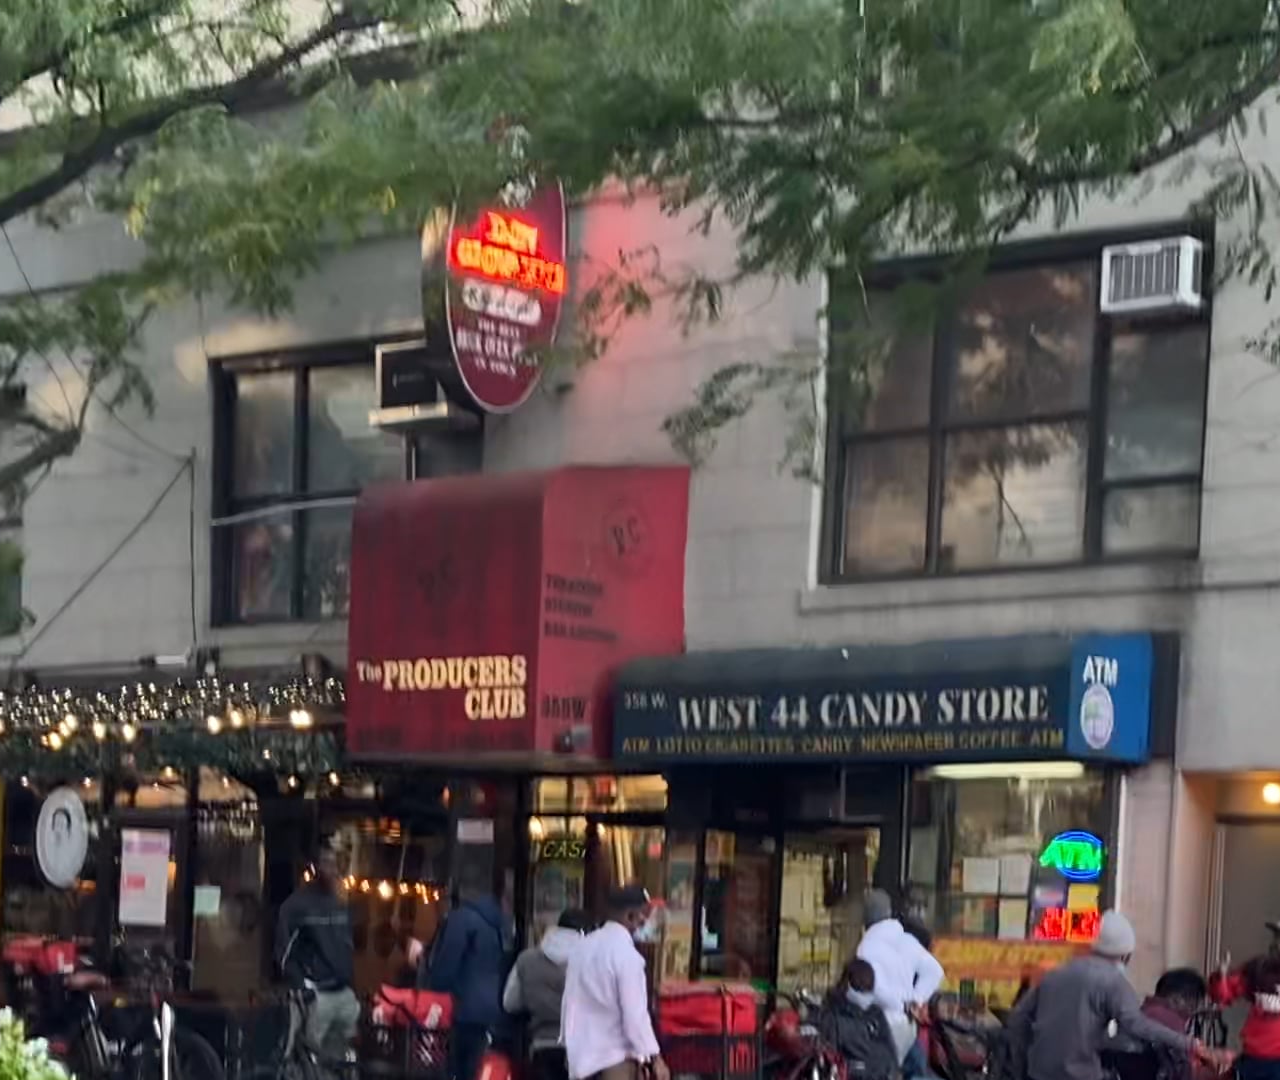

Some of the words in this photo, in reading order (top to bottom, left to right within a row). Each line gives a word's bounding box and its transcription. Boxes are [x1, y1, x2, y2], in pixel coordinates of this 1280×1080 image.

[382, 656, 527, 691] PRODUCERS
[1083, 655, 1119, 687] ATM
[464, 688, 526, 719] CLUB
[678, 696, 762, 732] WEST
[772, 694, 810, 729] 44
[819, 690, 928, 728] CANDY
[936, 686, 1050, 726] STORE
[623, 736, 651, 753] ATM
[1030, 726, 1064, 749] ATM
